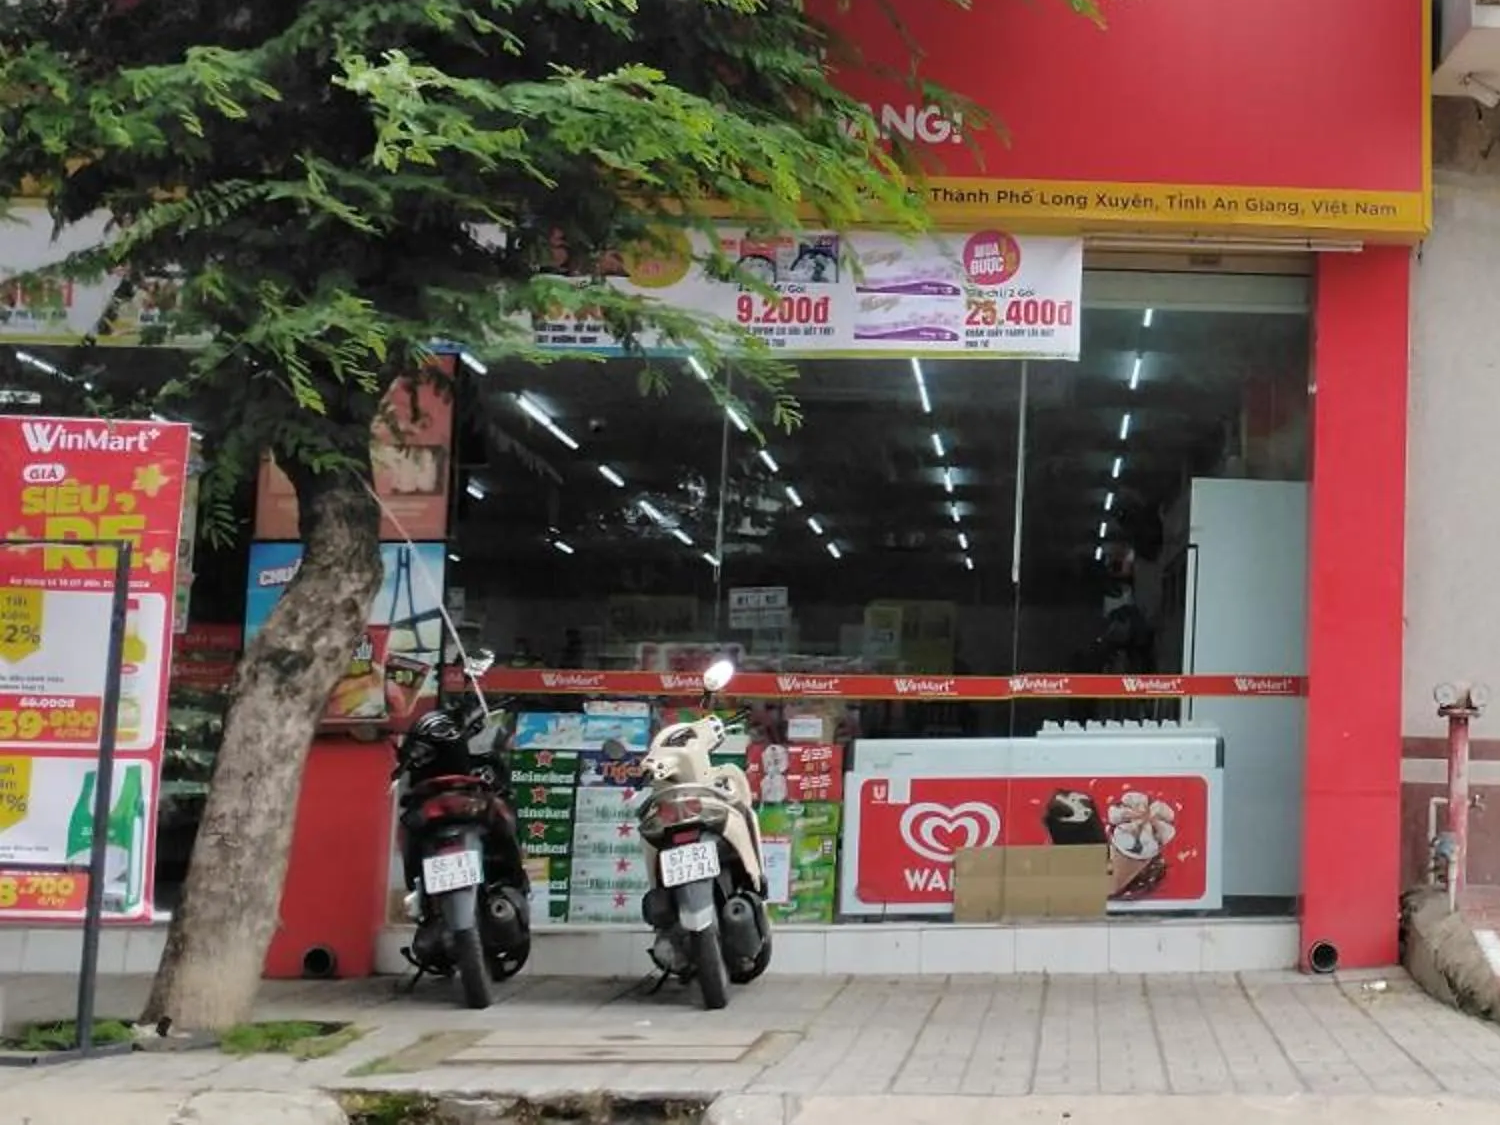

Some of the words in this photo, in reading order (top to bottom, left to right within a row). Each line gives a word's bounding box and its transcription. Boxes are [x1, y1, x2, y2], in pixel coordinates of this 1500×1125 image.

[997, 186, 1035, 205] Phố
[1040, 190, 1089, 211] Long
[1165, 190, 1207, 211] Tỉnh
[1213, 195, 1239, 211] An
[1246, 196, 1304, 218] Giang,
[1312, 198, 1348, 218] Việt
[1355, 201, 1397, 217] Nam
[21, 477, 110, 515] SIÊU
[44, 491, 147, 572] RẺ
[511, 770, 575, 785] Heineken
[517, 807, 571, 819] eineken
